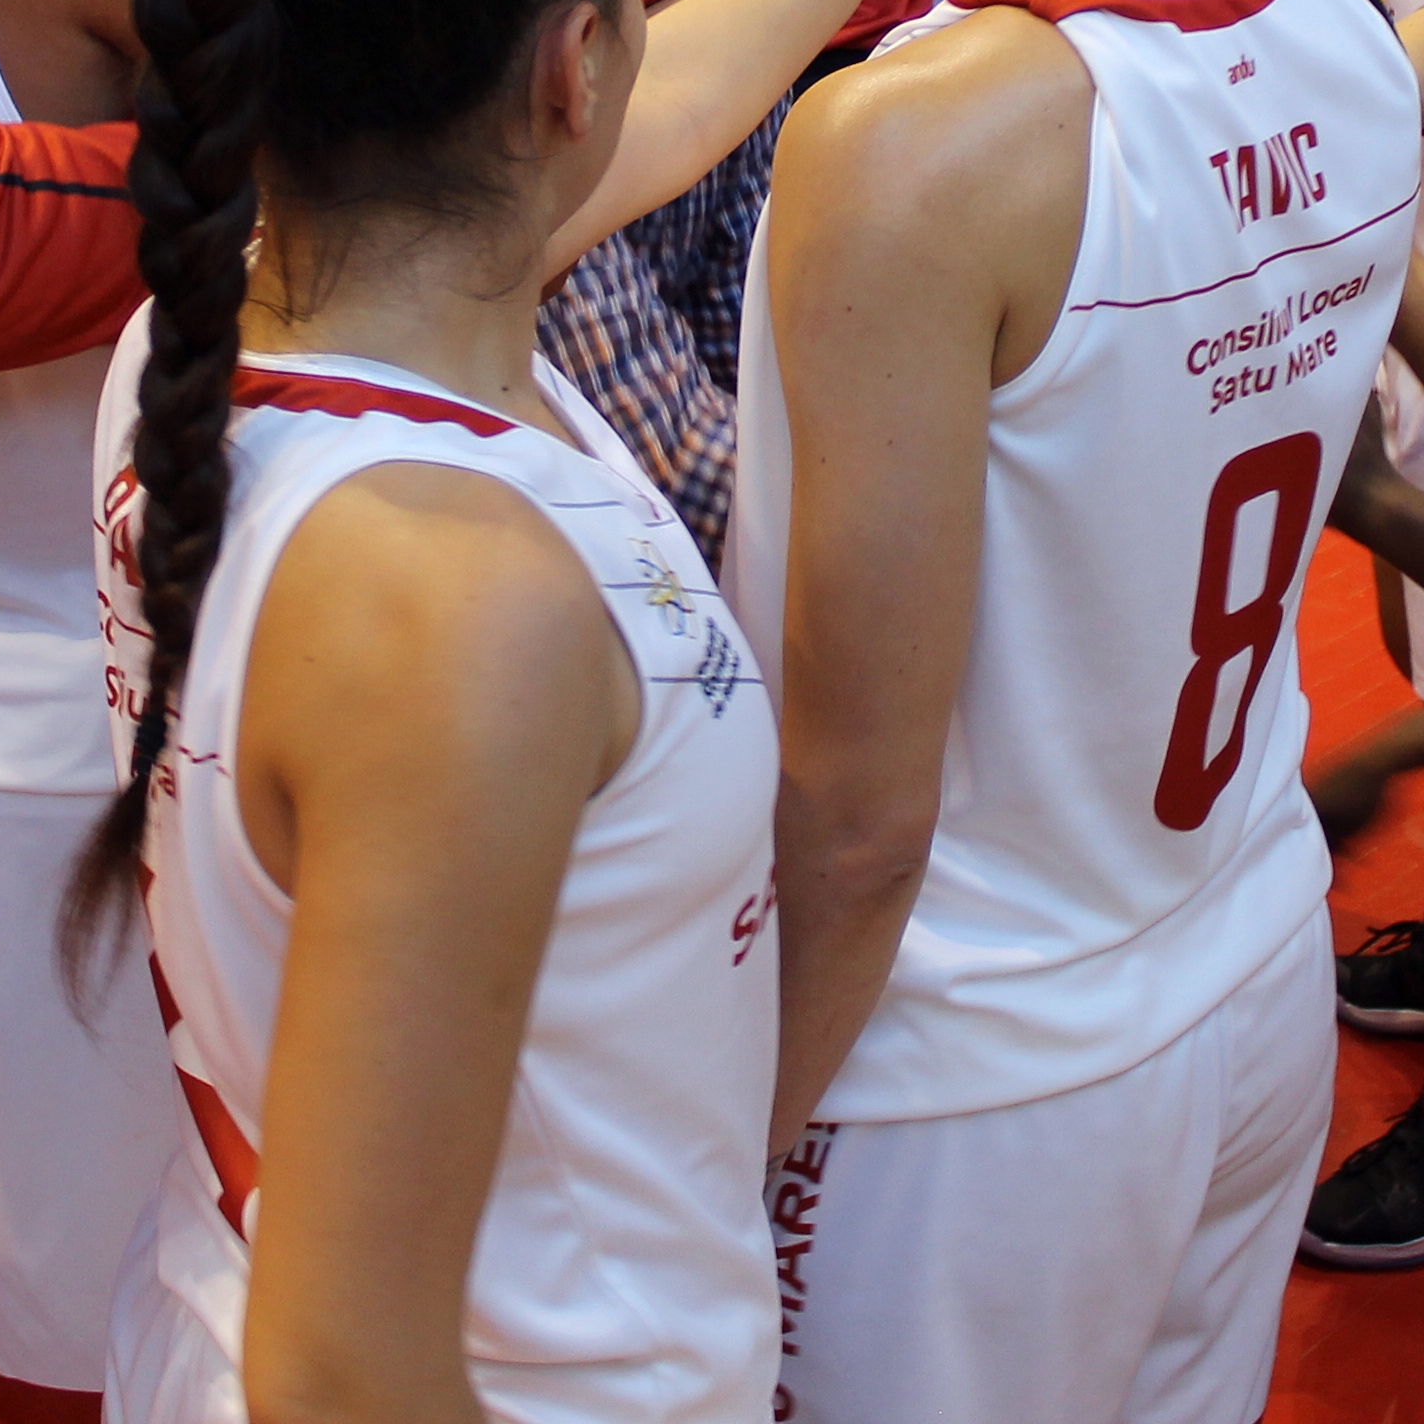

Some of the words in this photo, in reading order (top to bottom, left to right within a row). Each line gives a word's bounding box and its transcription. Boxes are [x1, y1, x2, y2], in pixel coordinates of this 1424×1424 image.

[1298, 262, 1376, 326] Local
[1209, 362, 1279, 416] Satu
[1285, 328, 1338, 387] Mare
[1153, 429, 1323, 832] 8
